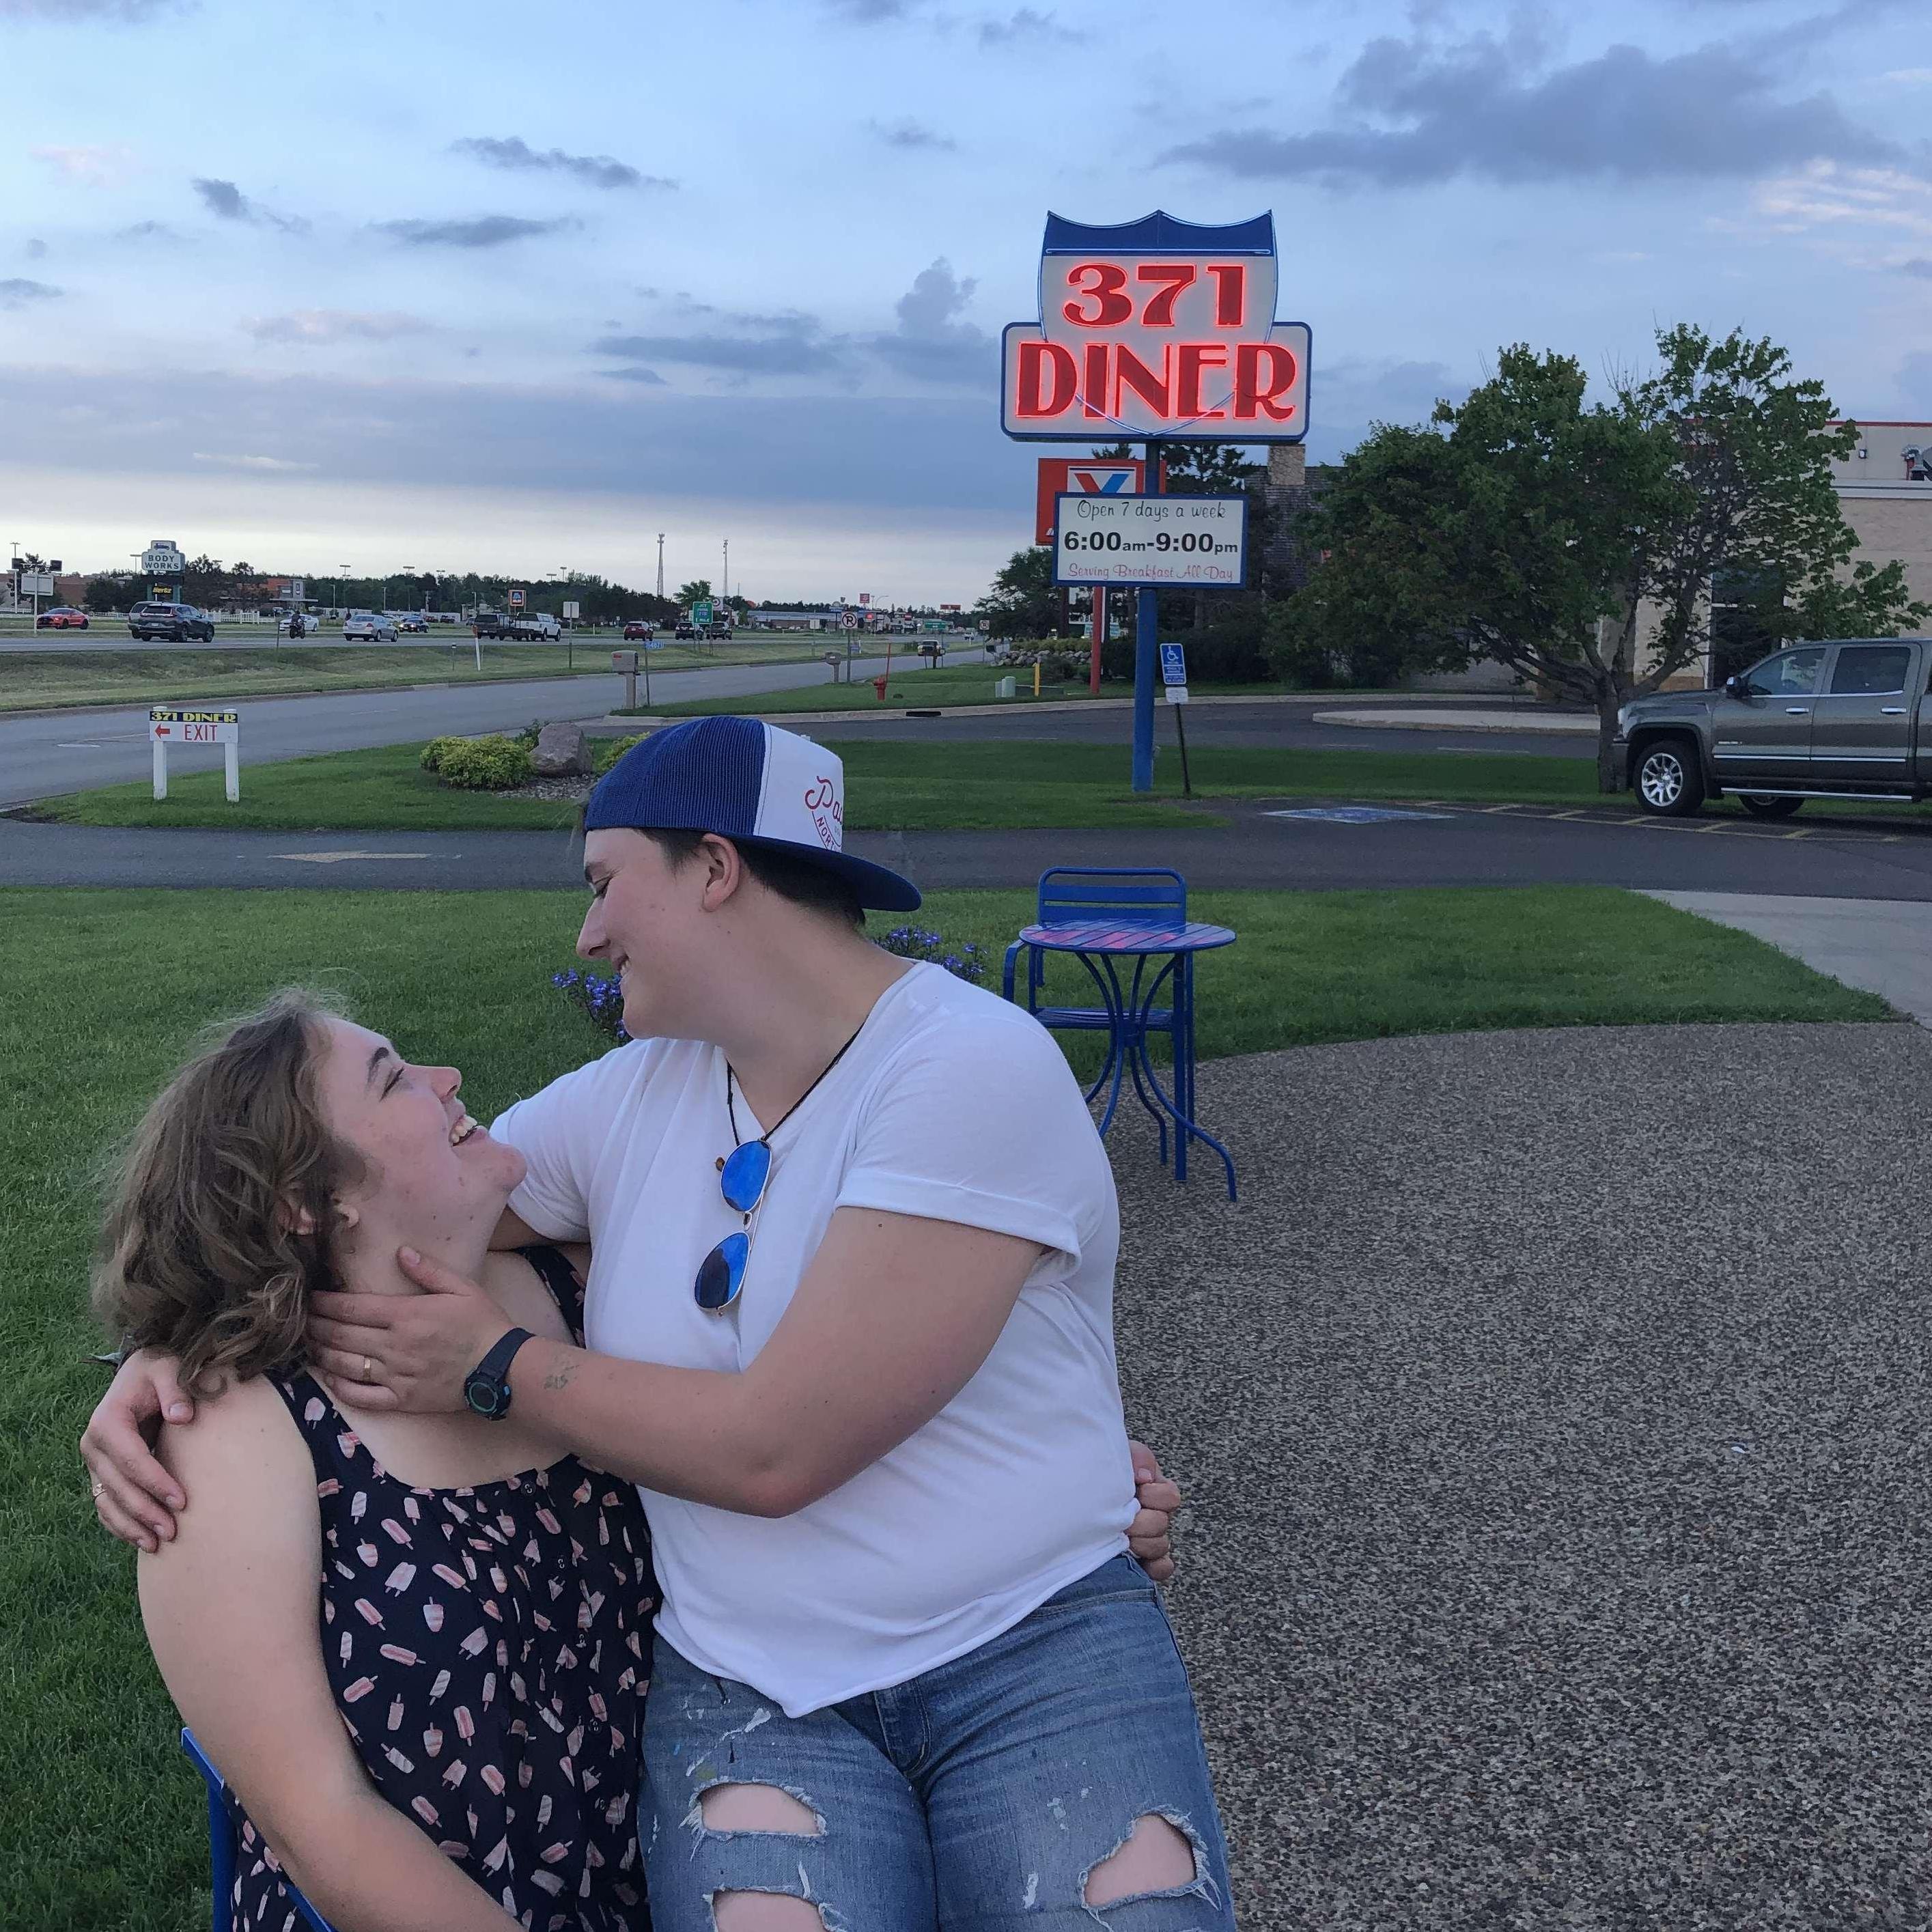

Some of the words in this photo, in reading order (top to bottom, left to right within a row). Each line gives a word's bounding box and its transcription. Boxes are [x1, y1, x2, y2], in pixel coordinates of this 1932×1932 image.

[1062, 262, 1246, 328] 371
[1015, 341, 1296, 421] DINER
[1078, 499, 1115, 521] Open
[1121, 501, 1130, 516] 7
[1135, 501, 1168, 522] days
[1175, 507, 1185, 518] a
[1191, 501, 1226, 518] week
[1064, 531, 1238, 555] 6:00am-9:00pm
[148, 555, 175, 563] BODY
[1068, 563, 1109, 580] Serving
[1112, 564, 1174, 580] Breakfast
[1176, 565, 1201, 578] All
[1204, 565, 1233, 582] Day
[151, 712, 178, 721] 371
[182, 712, 236, 723] DINER
[184, 724, 218, 742] EXIT
